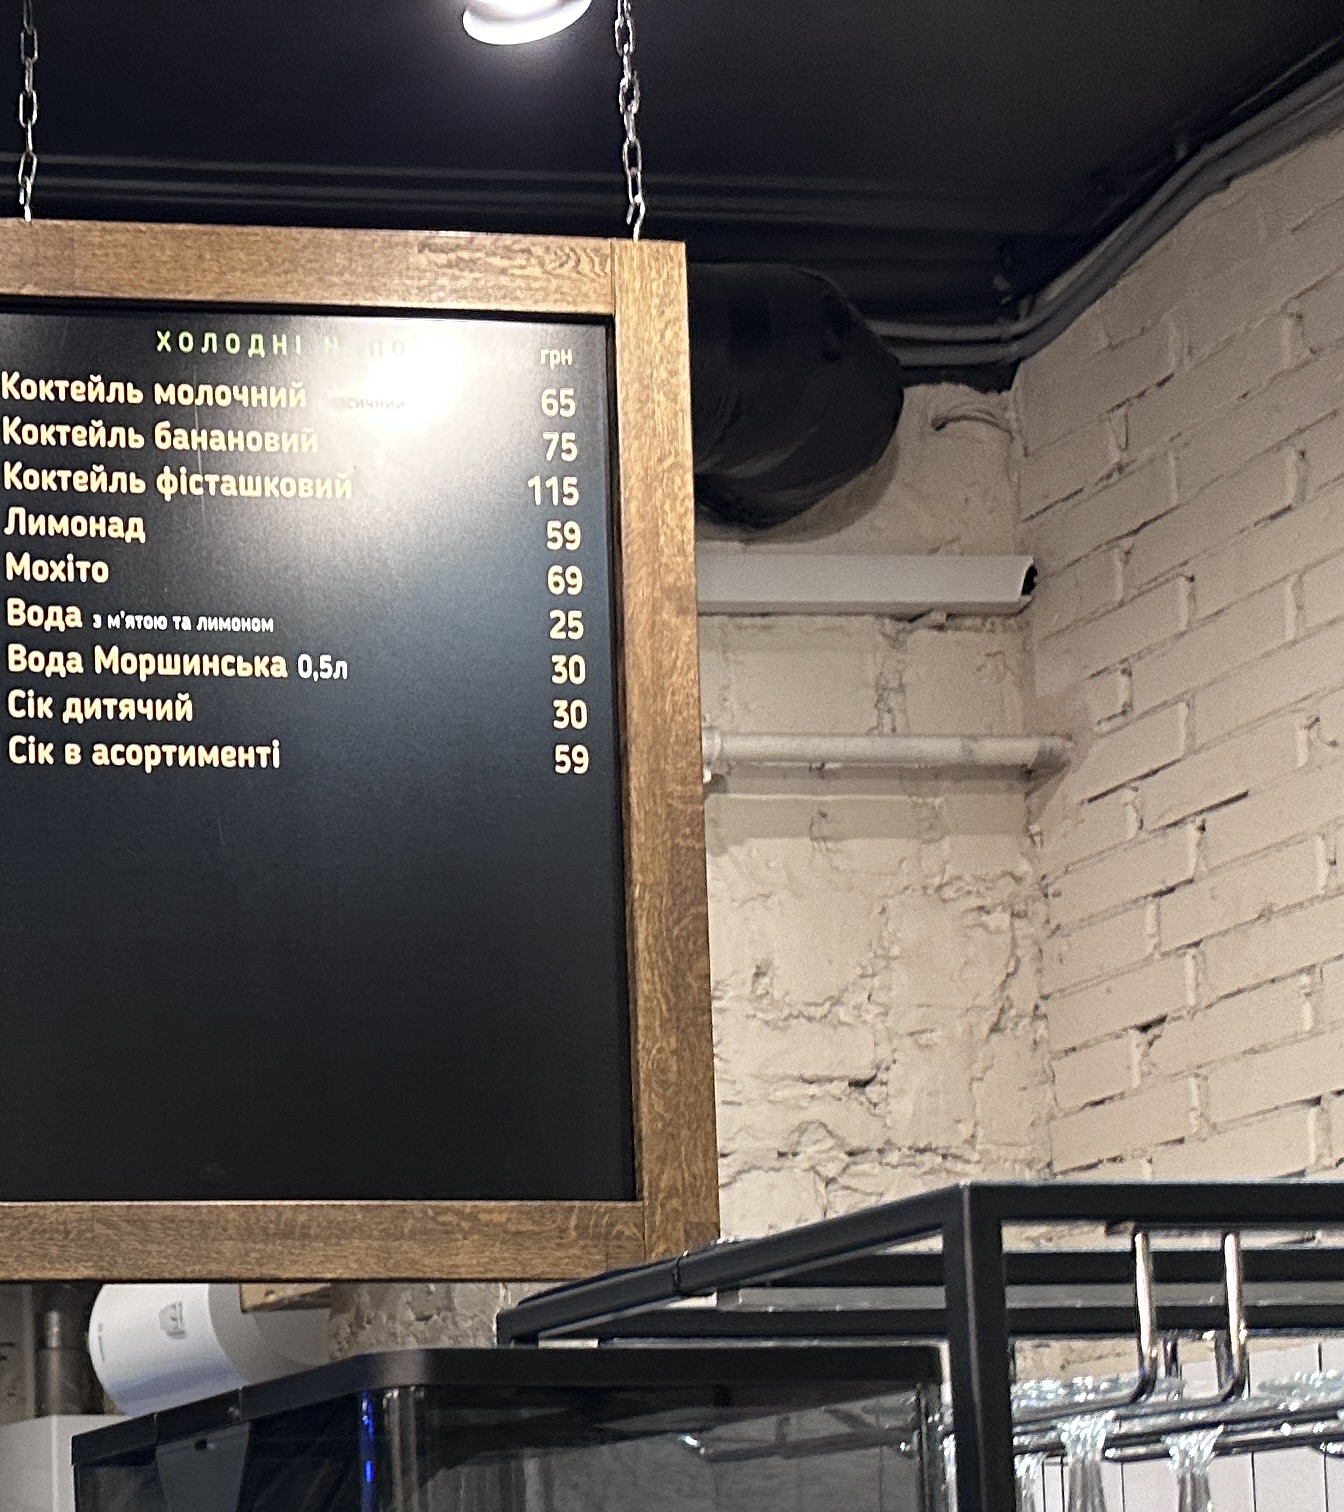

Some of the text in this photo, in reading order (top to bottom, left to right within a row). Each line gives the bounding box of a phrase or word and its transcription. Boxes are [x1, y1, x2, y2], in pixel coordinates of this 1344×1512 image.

[157, 331, 303, 357] ХОЛОДНІ
[541, 348, 573, 369] грн
[2, 371, 143, 403] Коктейль
[154, 381, 306, 408] молочний
[542, 388, 576, 417] 65
[4, 461, 579, 506] Коктейль фісташковий 115
[6, 552, 582, 595] Мохіто 69
[7, 598, 584, 639] Вода з м'ятою та лимоном 25
[8, 644, 585, 684] Вода Моршинська 0,5л 30
[9, 735, 589, 774] Сік в асортименті 59
